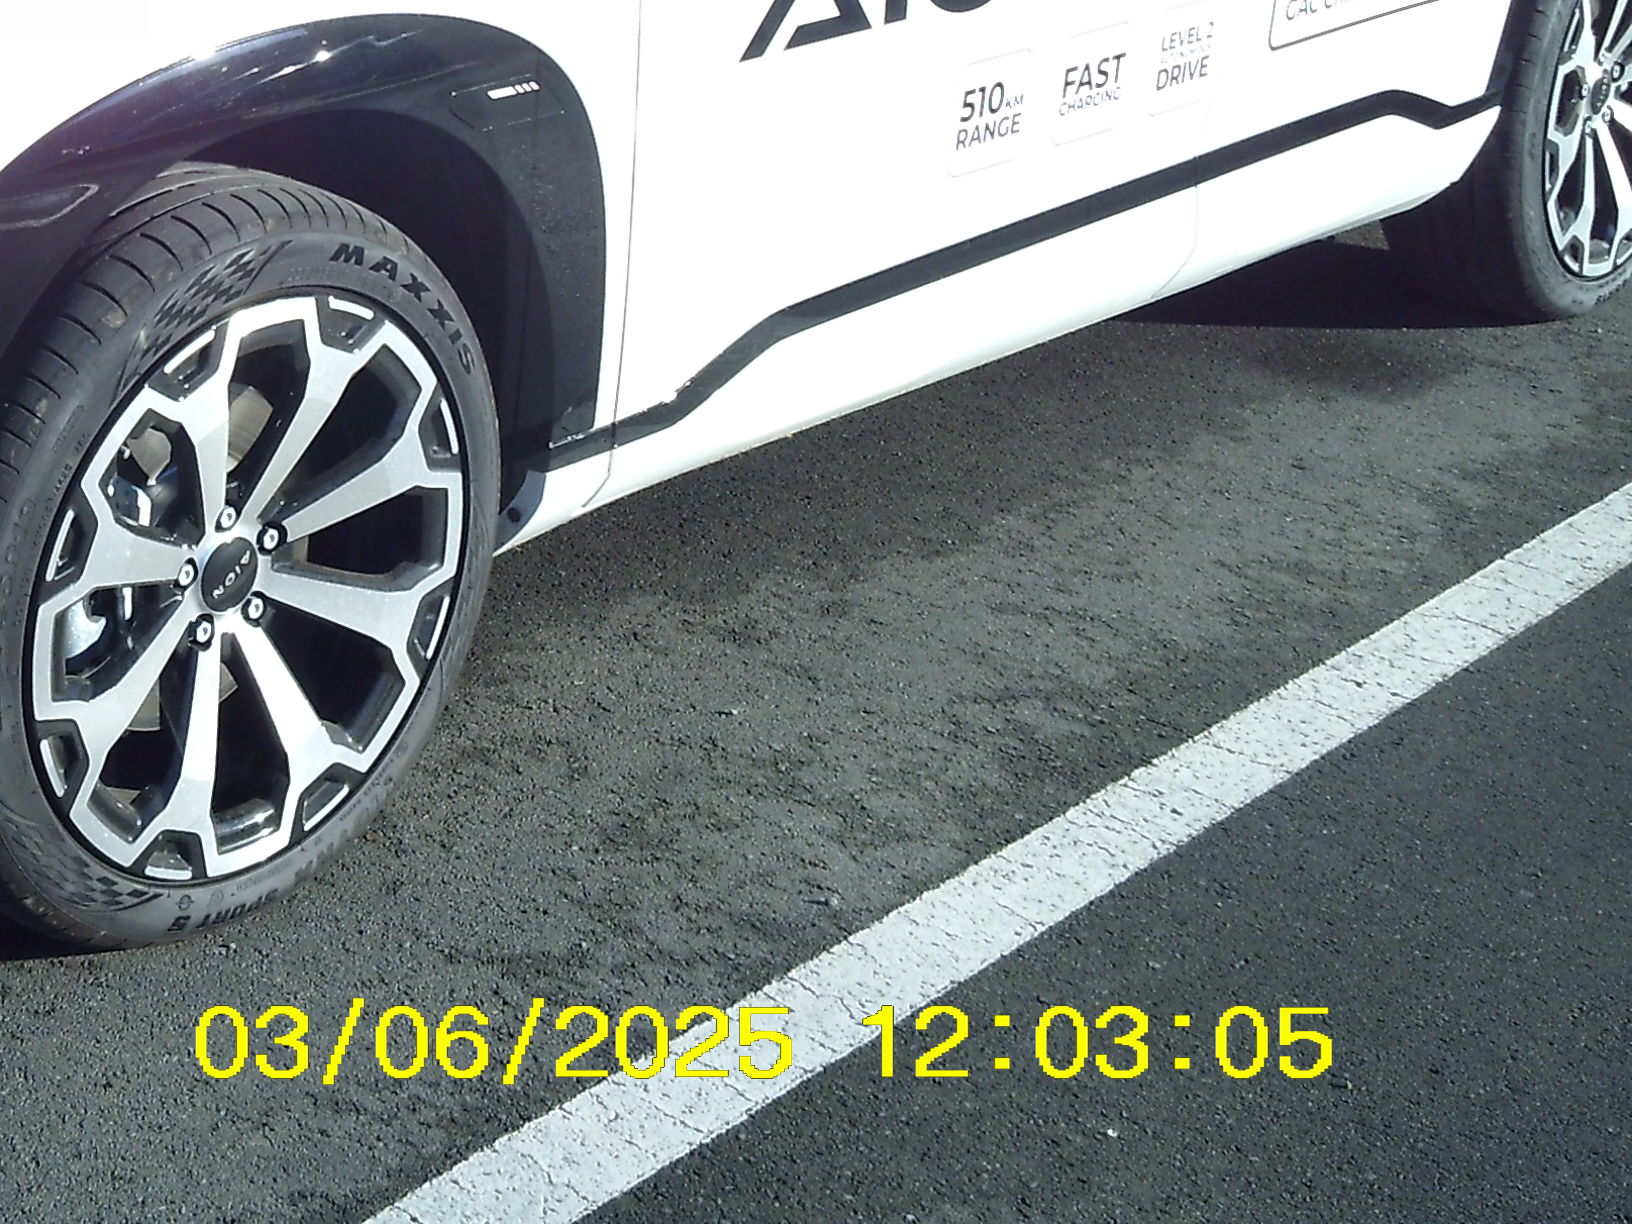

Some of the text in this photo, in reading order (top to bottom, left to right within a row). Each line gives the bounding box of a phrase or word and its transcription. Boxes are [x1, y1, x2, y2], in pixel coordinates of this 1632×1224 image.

[1161, 21, 1215, 53] LEVEL 2
[1062, 53, 1128, 99] FAST
[1155, 56, 1211, 92] DRIVE
[1058, 87, 1122, 116] CHARGING
[955, 113, 1023, 151] RANGE
[329, 242, 477, 377] MAXXIS
[212, 550, 250, 599] AION
